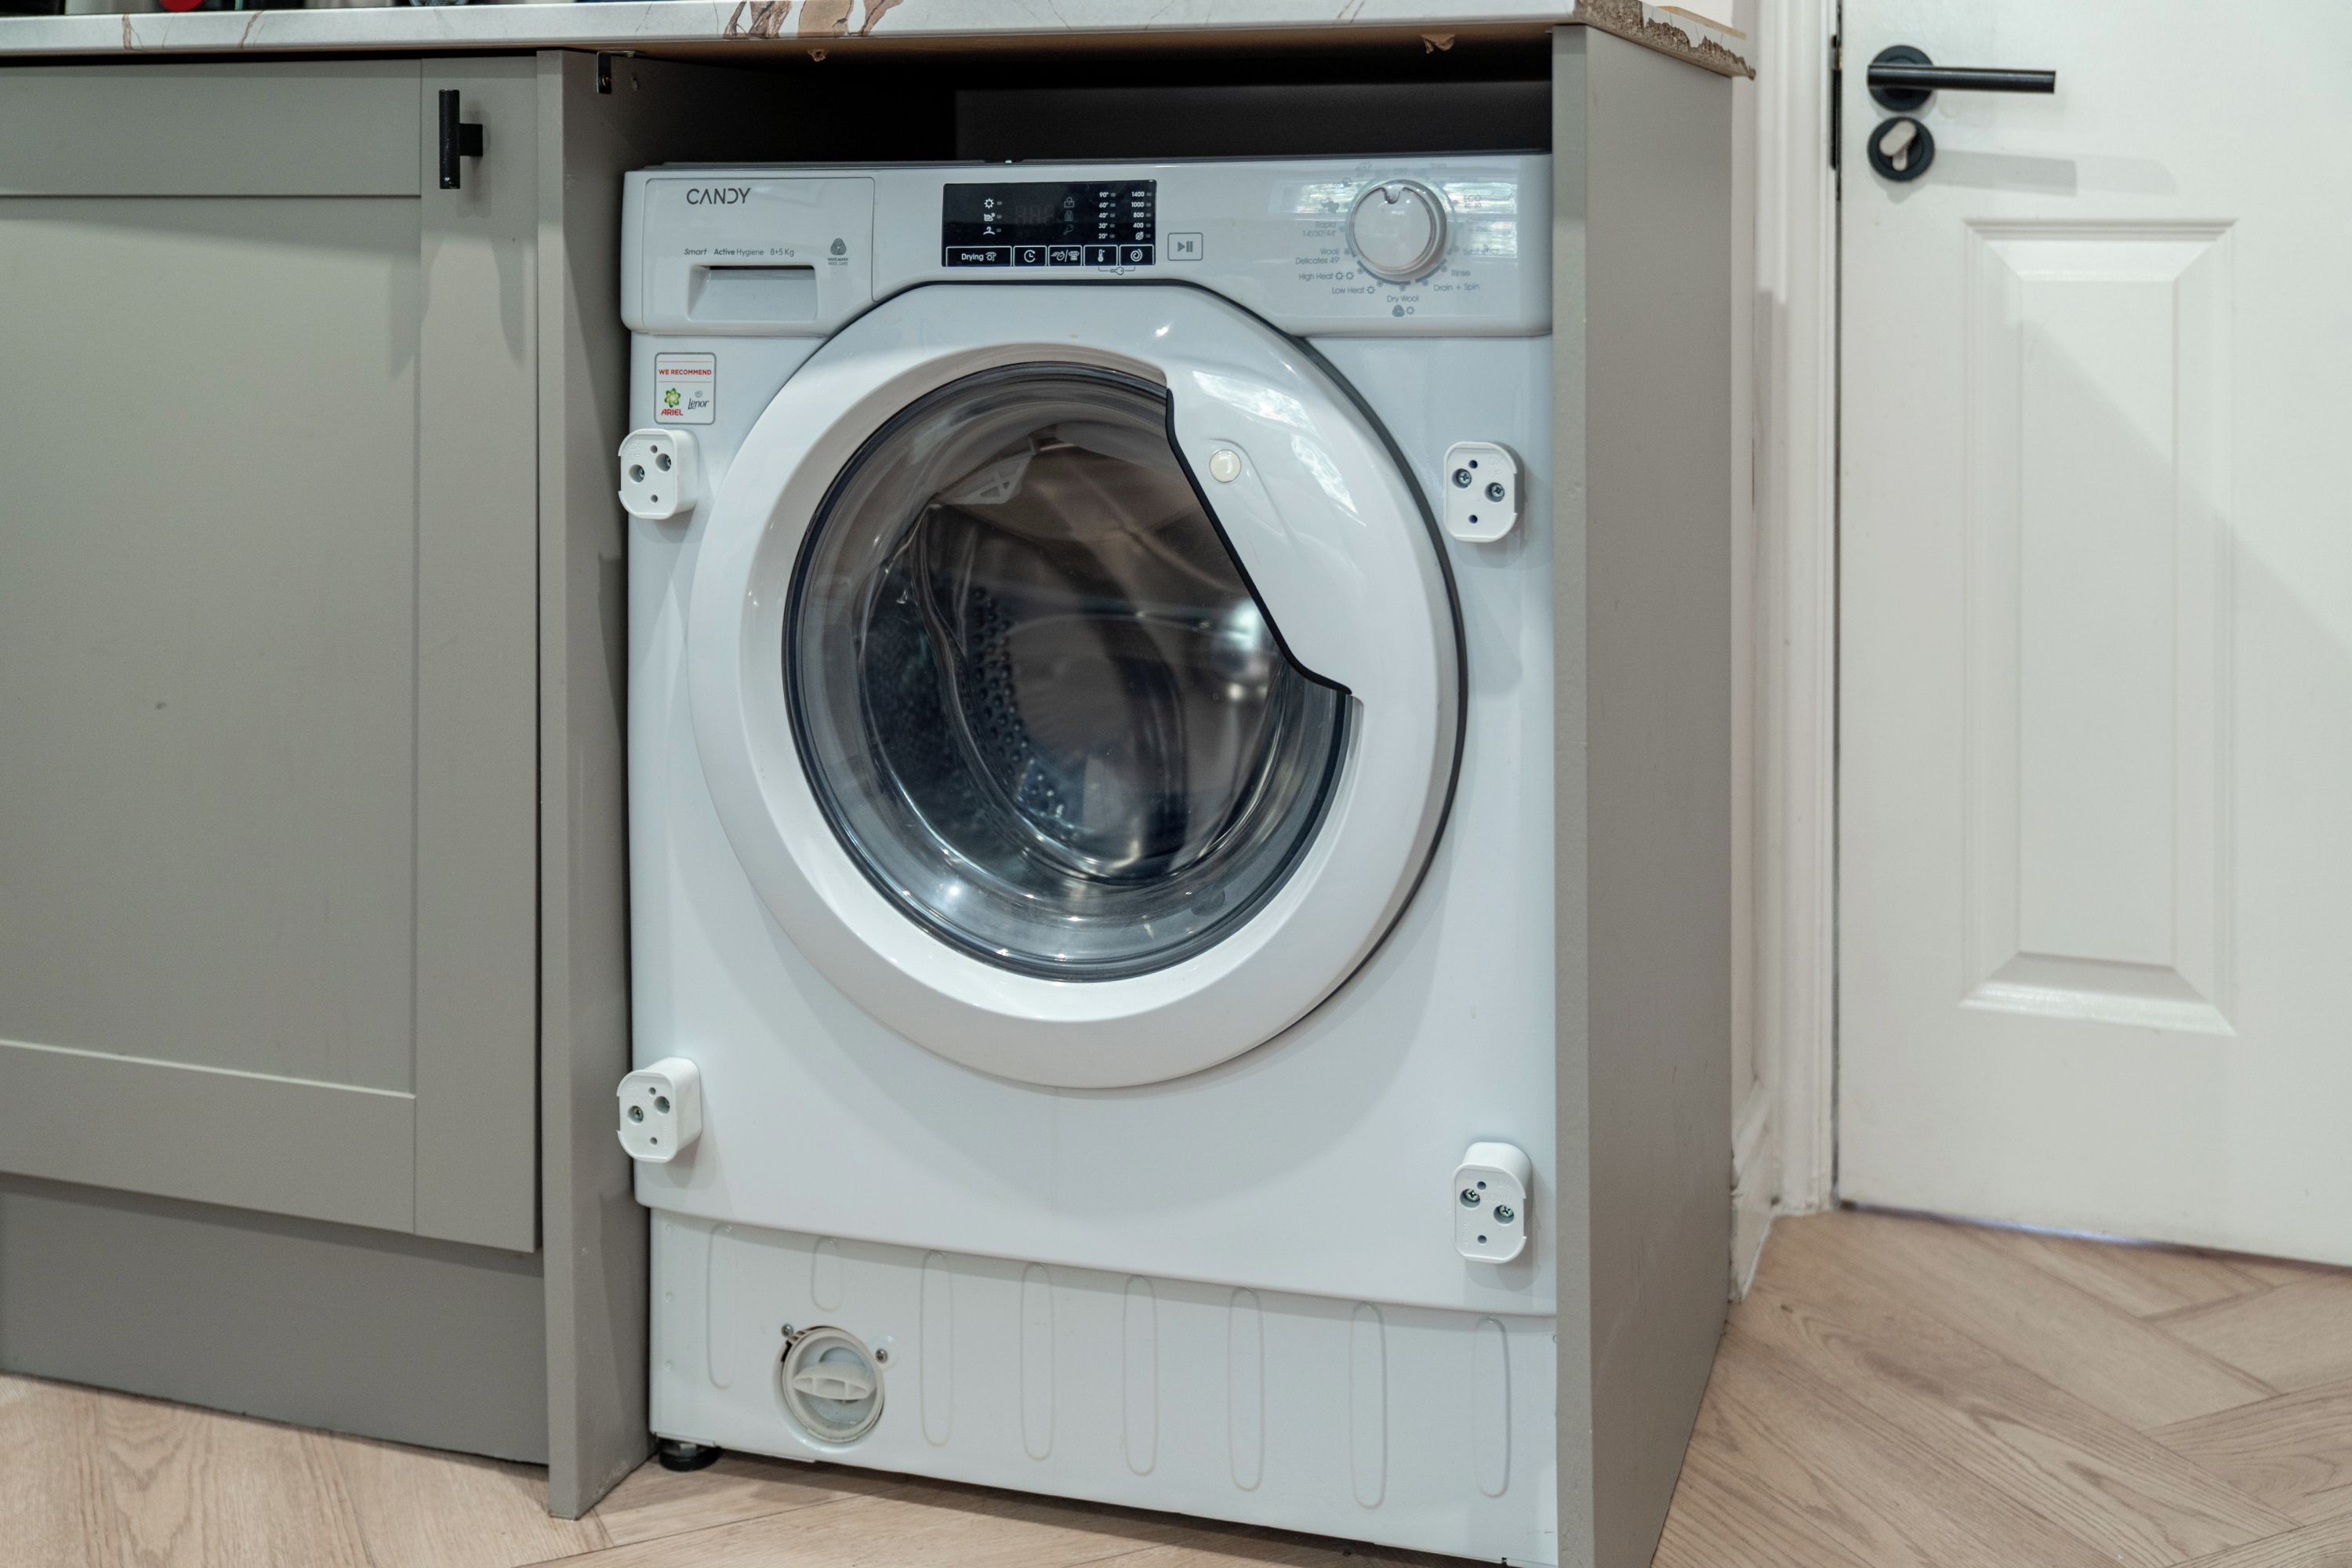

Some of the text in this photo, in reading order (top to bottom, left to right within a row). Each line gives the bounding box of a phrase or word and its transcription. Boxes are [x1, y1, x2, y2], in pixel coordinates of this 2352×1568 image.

[686, 187, 750, 205] CANDY
[736, 248, 764, 257] Hygiene
[785, 248, 794, 257] Kg
[1298, 273, 1315, 281] High
[1464, 283, 1480, 292] Spin
[688, 397, 710, 410] Lenor
